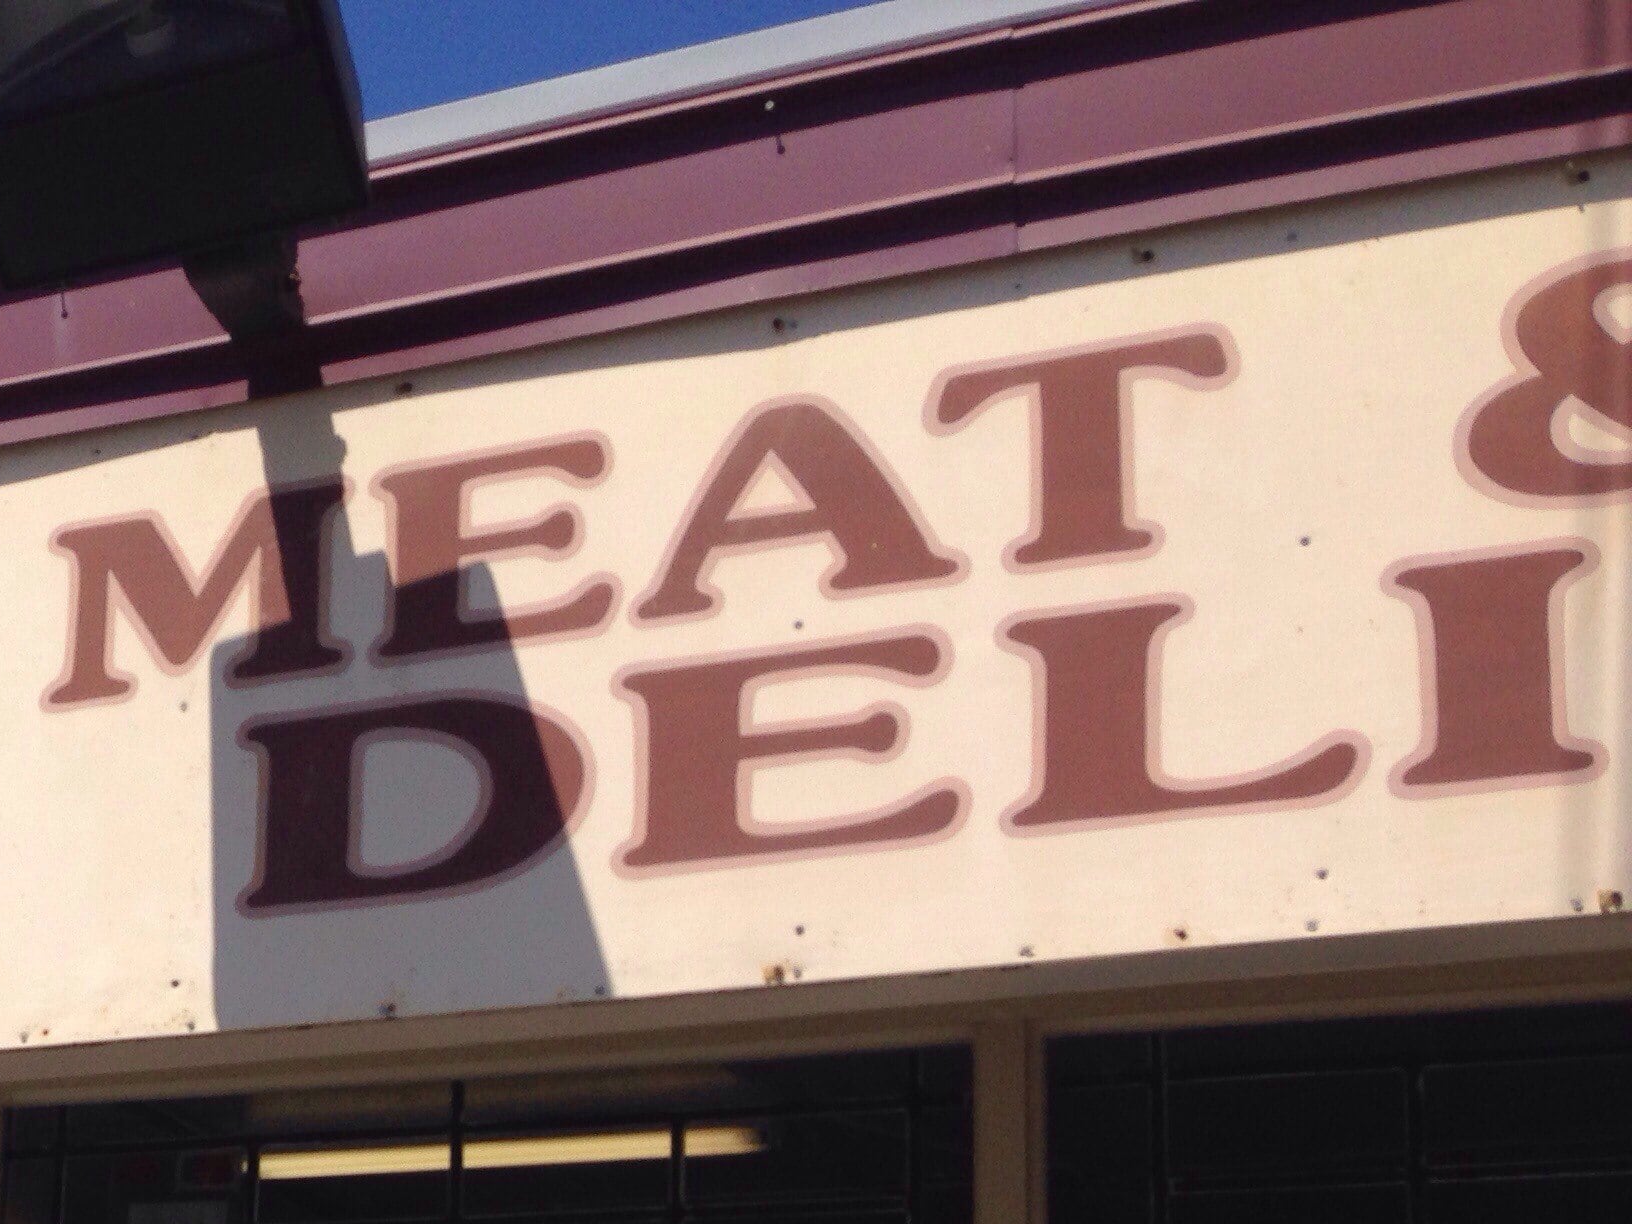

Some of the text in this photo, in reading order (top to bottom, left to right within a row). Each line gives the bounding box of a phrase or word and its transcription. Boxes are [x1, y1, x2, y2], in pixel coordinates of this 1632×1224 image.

[39, 246, 1632, 714] MEAT &
[235, 536, 1610, 920] DELI
